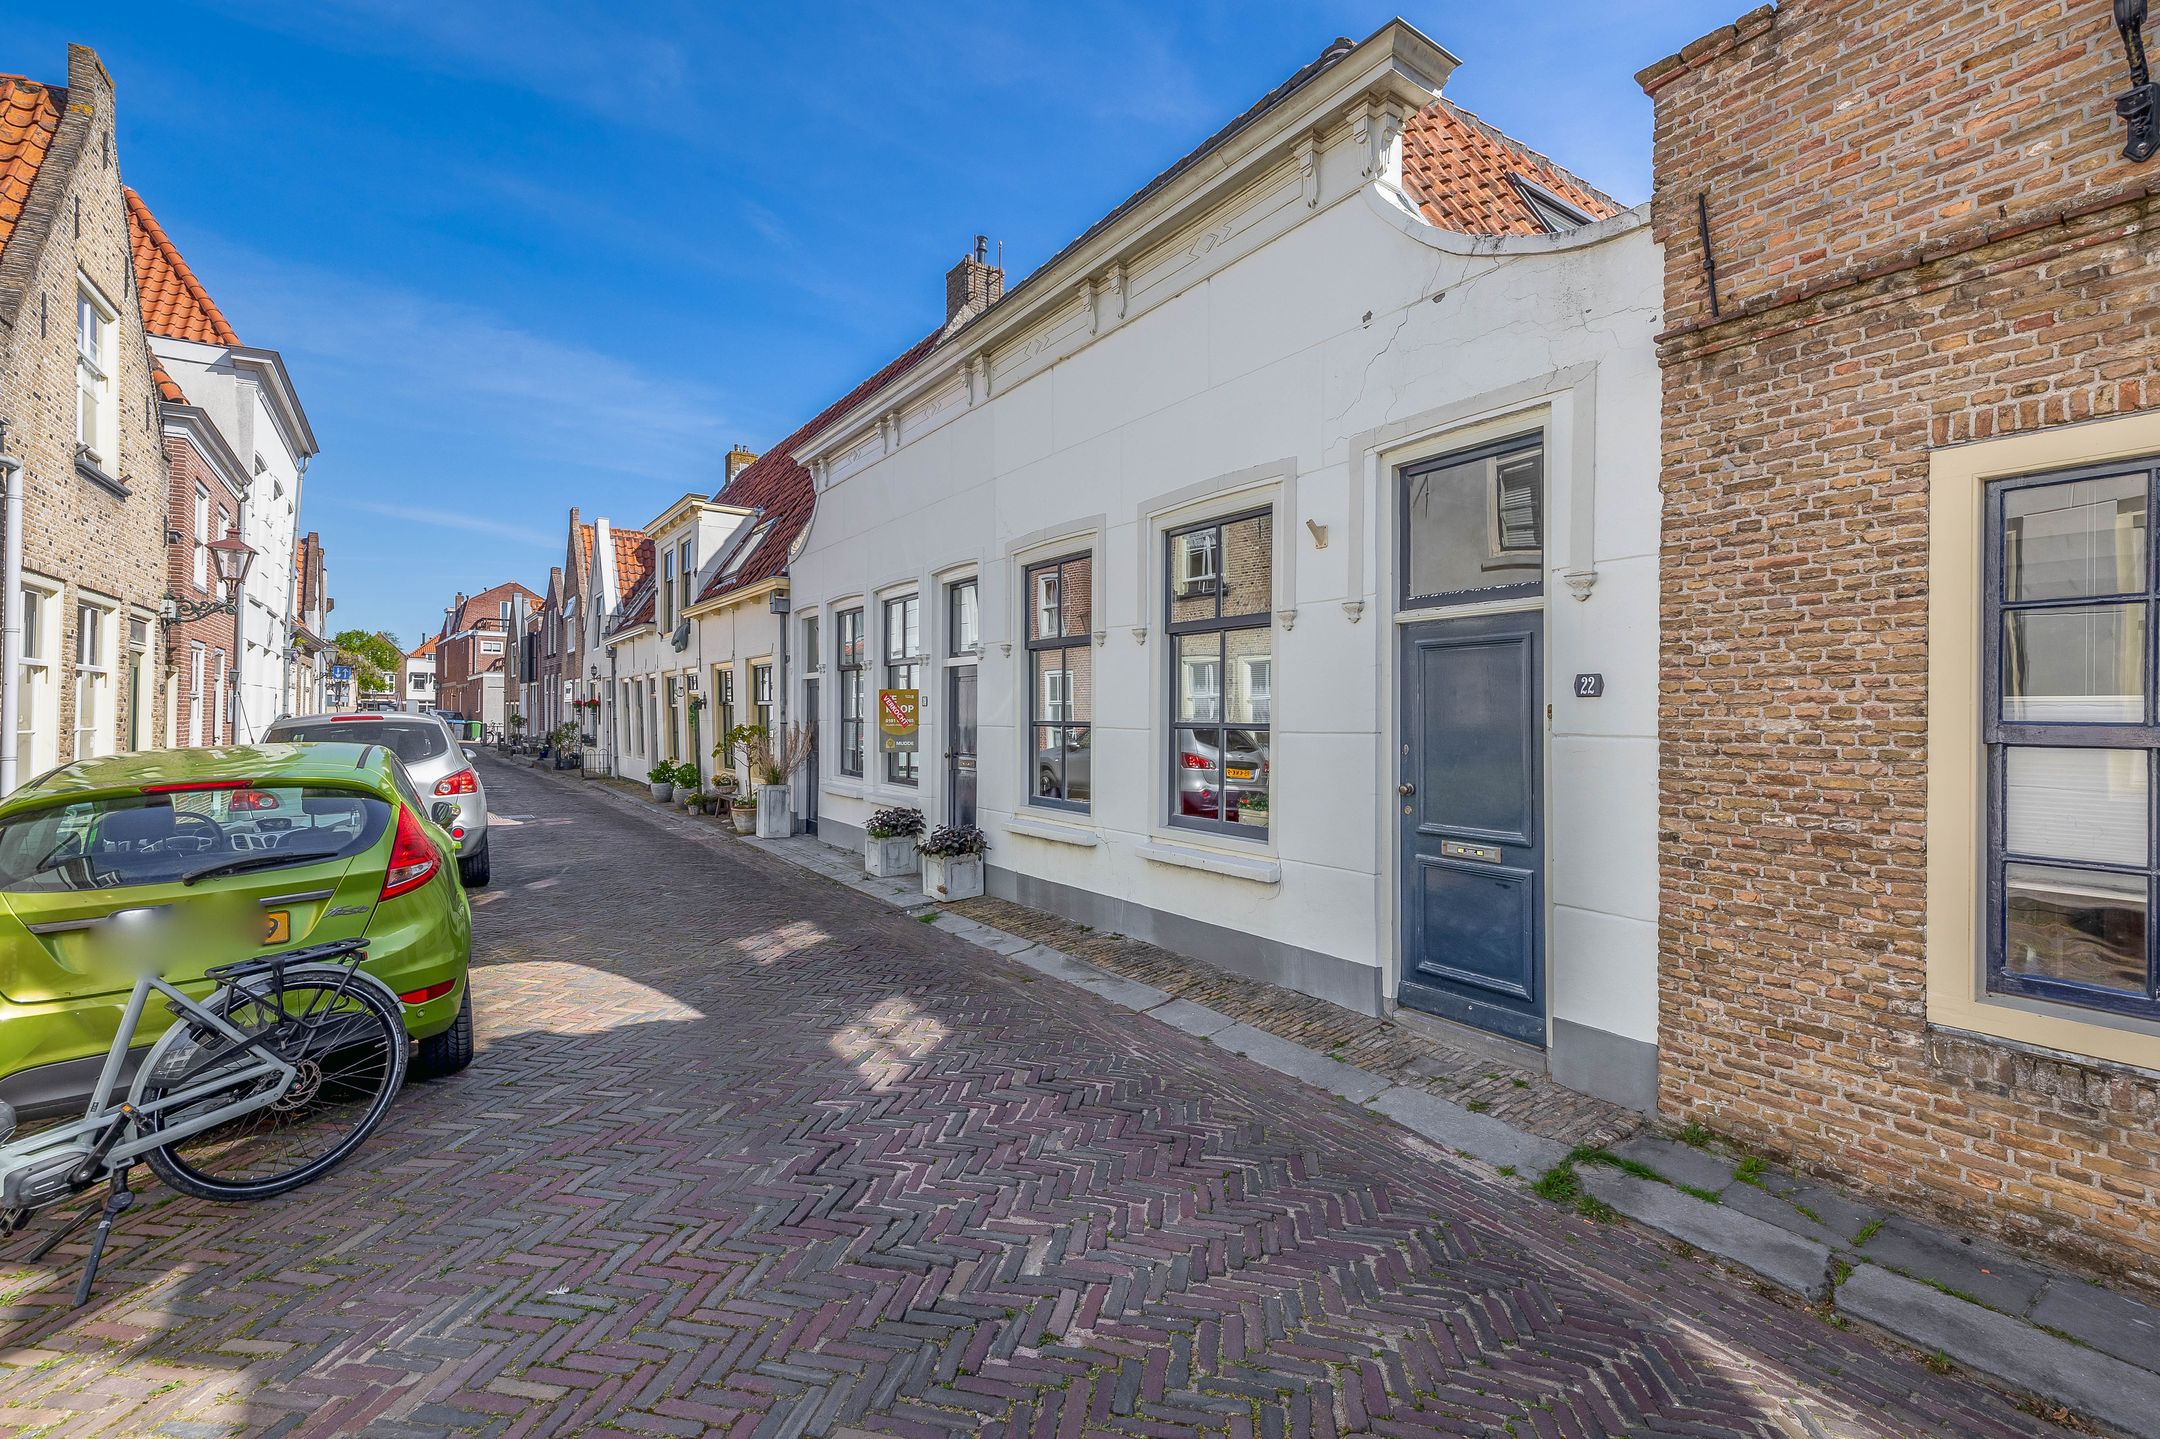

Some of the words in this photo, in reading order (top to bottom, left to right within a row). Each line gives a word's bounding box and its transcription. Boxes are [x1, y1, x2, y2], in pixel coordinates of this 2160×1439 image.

[1580, 676, 1595, 695] 22
[883, 695, 909, 725] VERKOCHT
[885, 704, 914, 713] KOP
